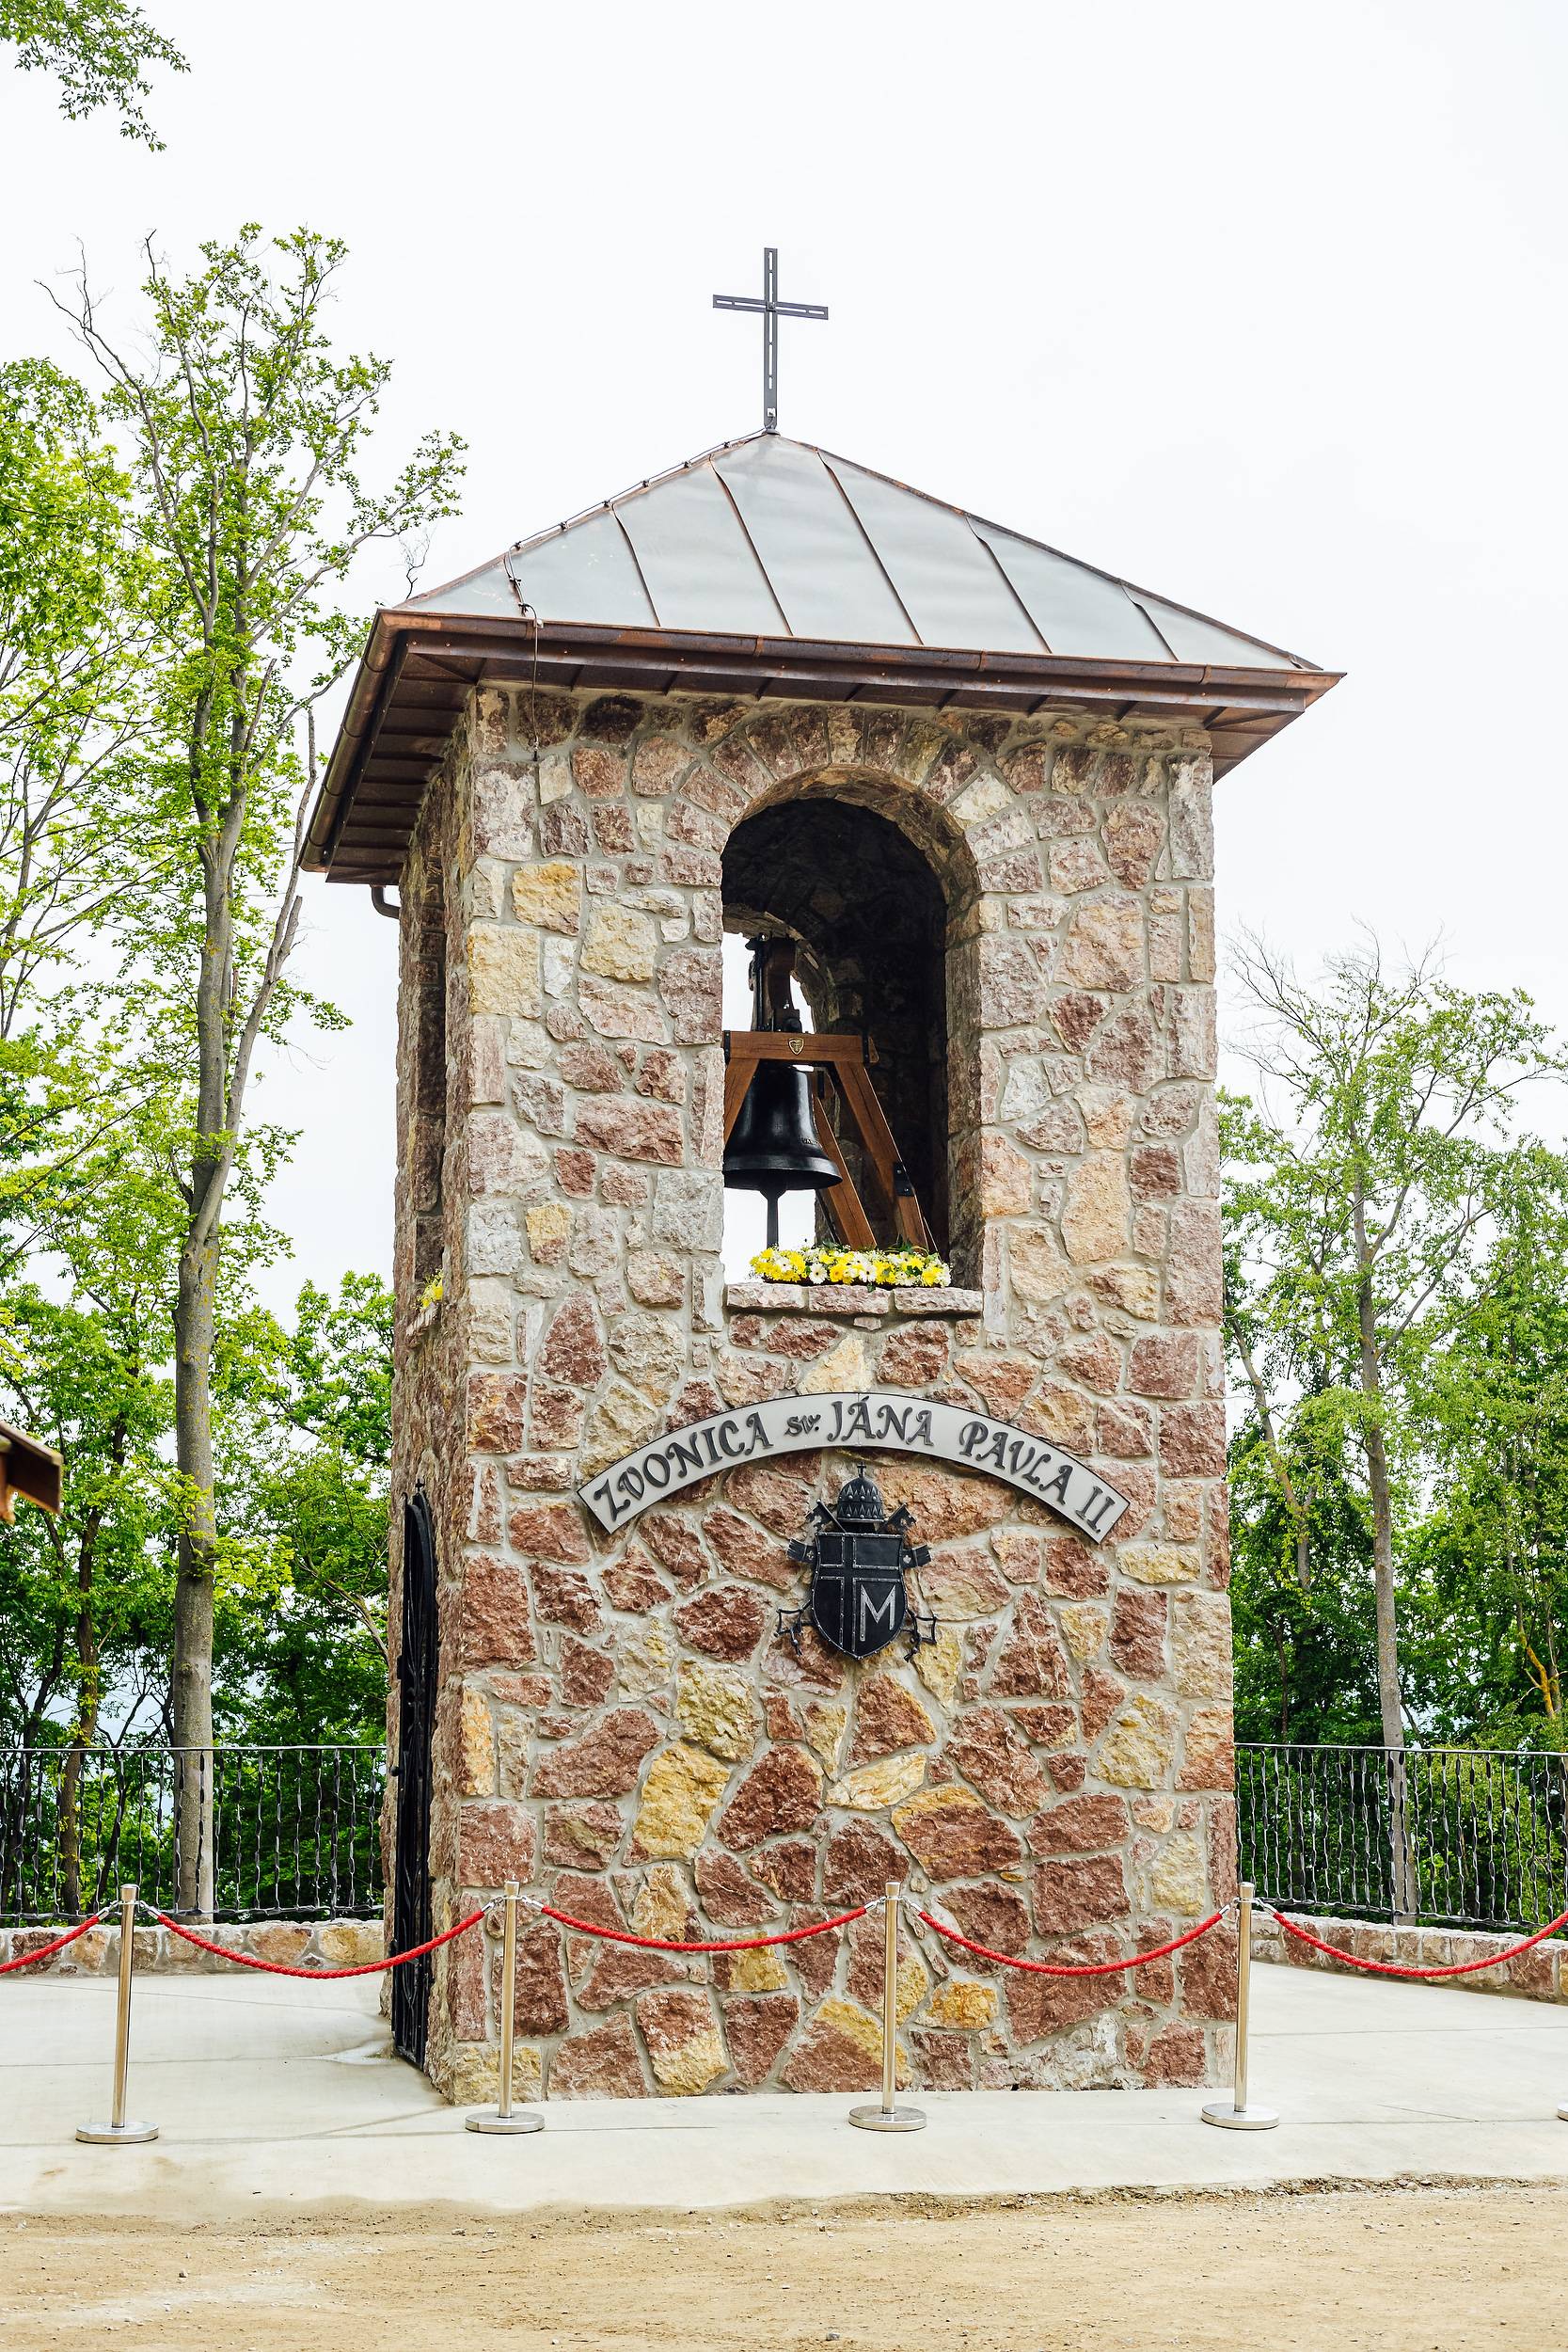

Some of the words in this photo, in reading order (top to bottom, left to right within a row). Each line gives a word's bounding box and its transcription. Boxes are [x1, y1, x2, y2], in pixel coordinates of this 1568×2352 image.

[594, 1411, 774, 1522] ZVONICA
[827, 1395, 934, 1446] JÁNA
[958, 1421, 1073, 1505] PAVLA
[859, 1584, 896, 1642] M
